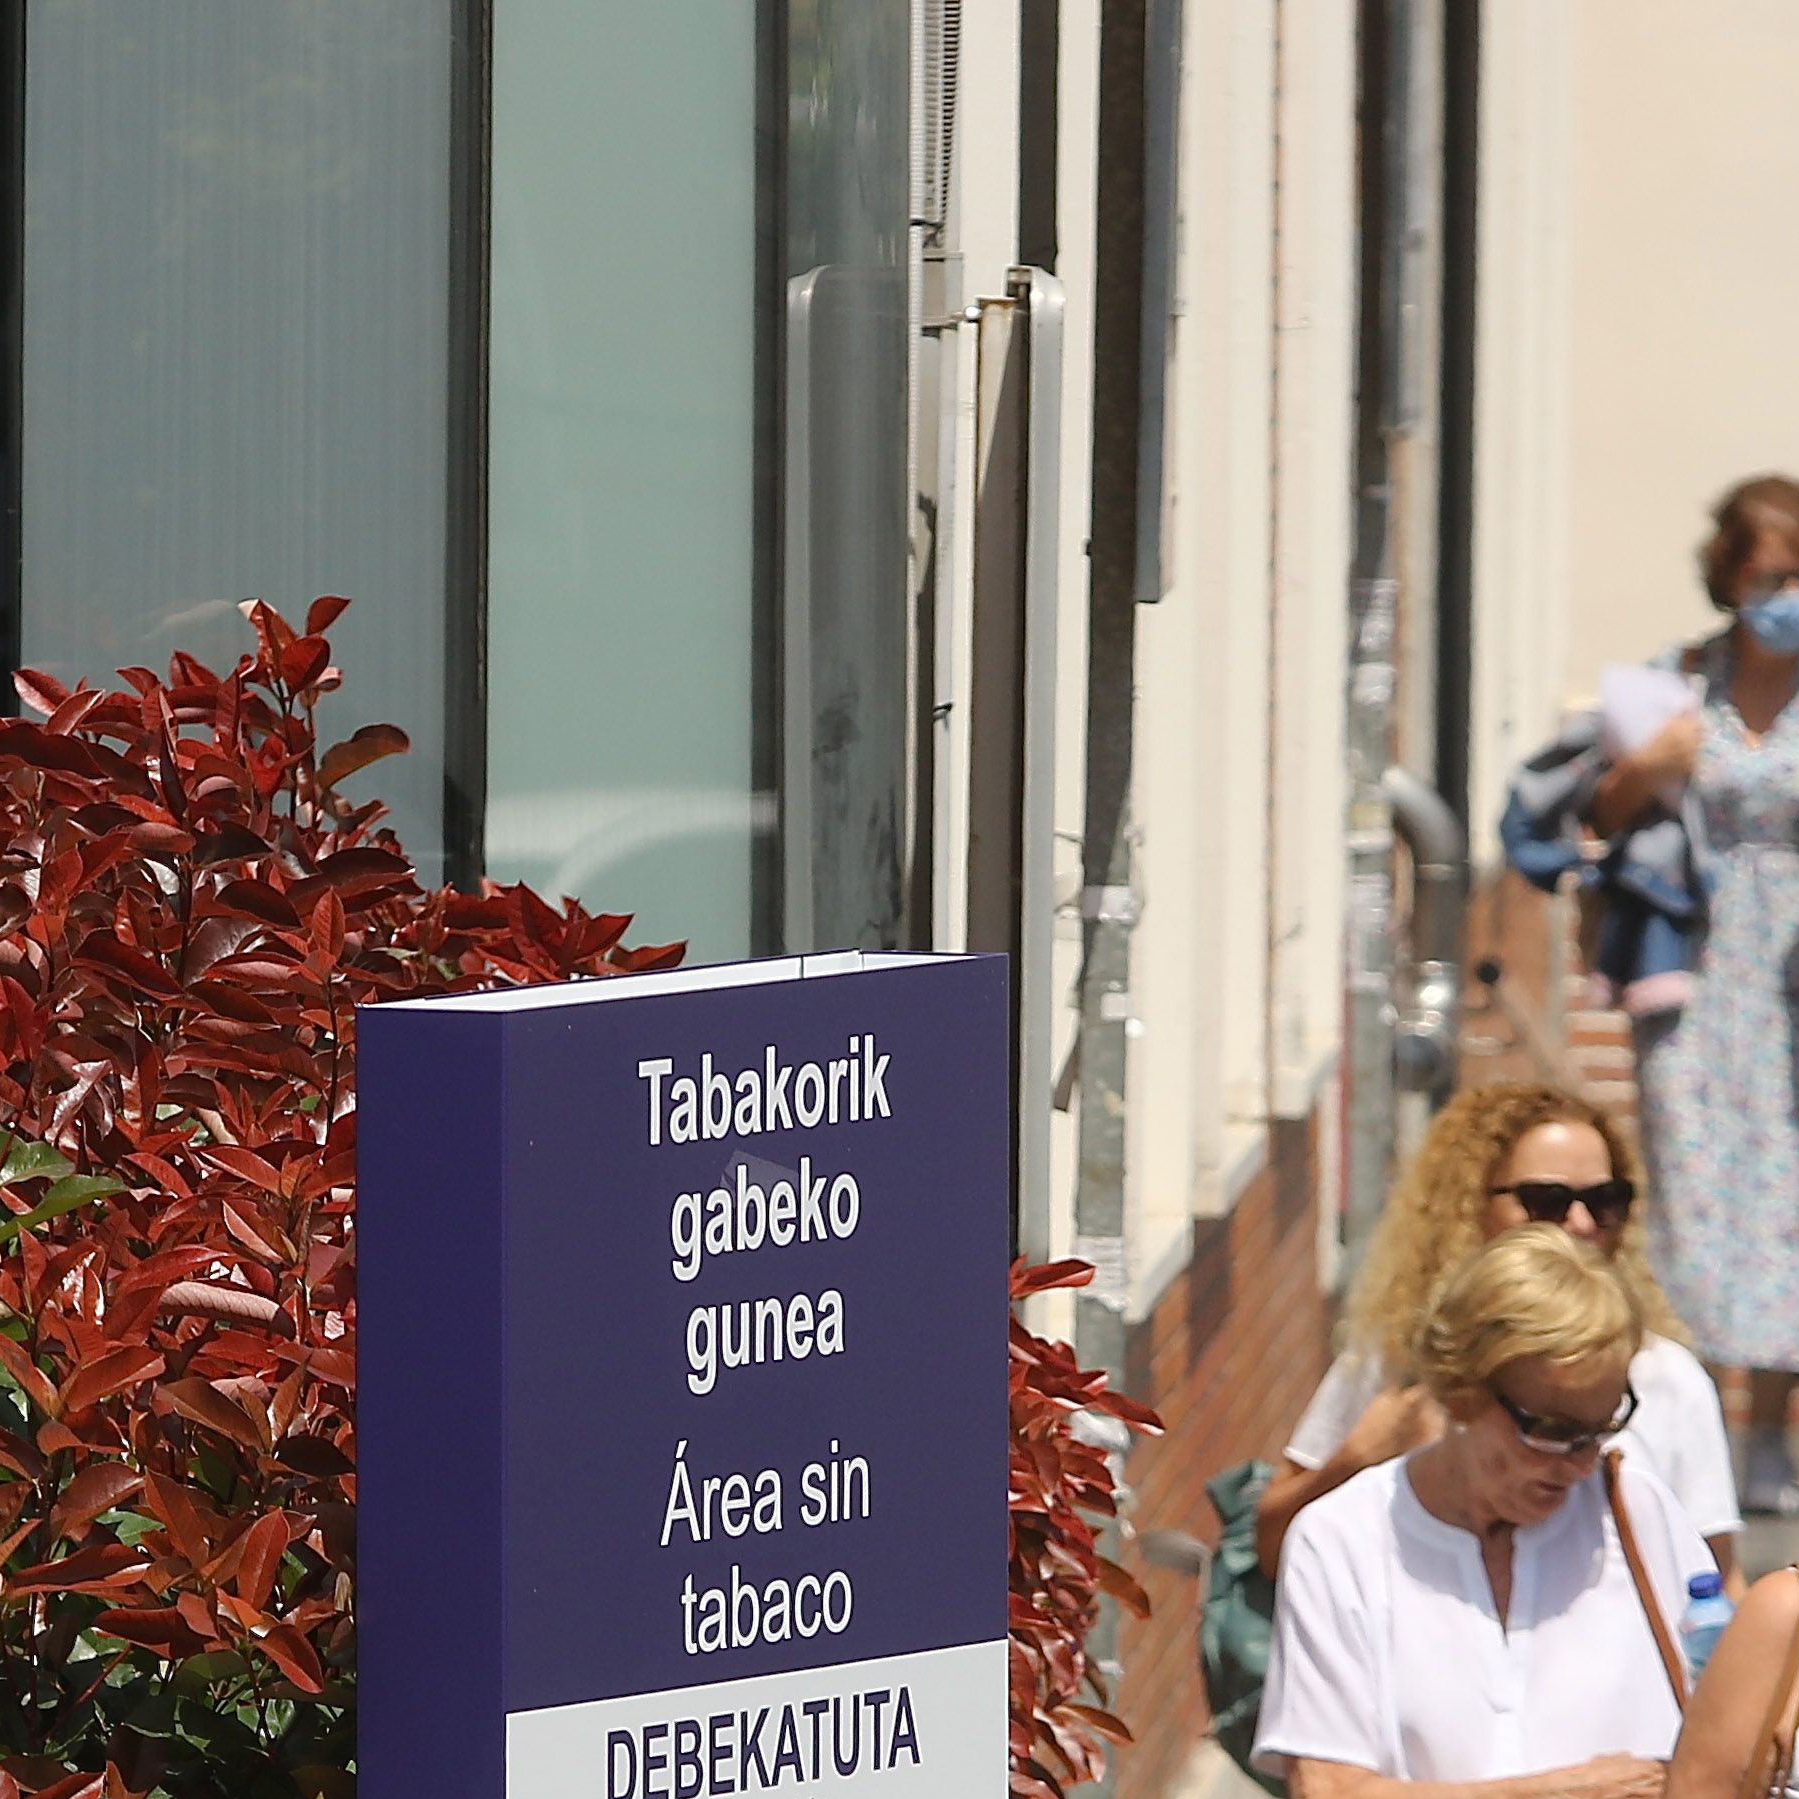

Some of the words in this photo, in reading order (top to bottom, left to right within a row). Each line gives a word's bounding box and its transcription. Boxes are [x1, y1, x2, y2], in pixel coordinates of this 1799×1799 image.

[639, 1034, 893, 1145] Tabakorik
[670, 1156, 860, 1281] gabeko
[686, 1289, 845, 1395] gunea
[660, 1441, 782, 1546] Área
[800, 1440, 871, 1526] sin
[680, 1565, 853, 1654] tabaco
